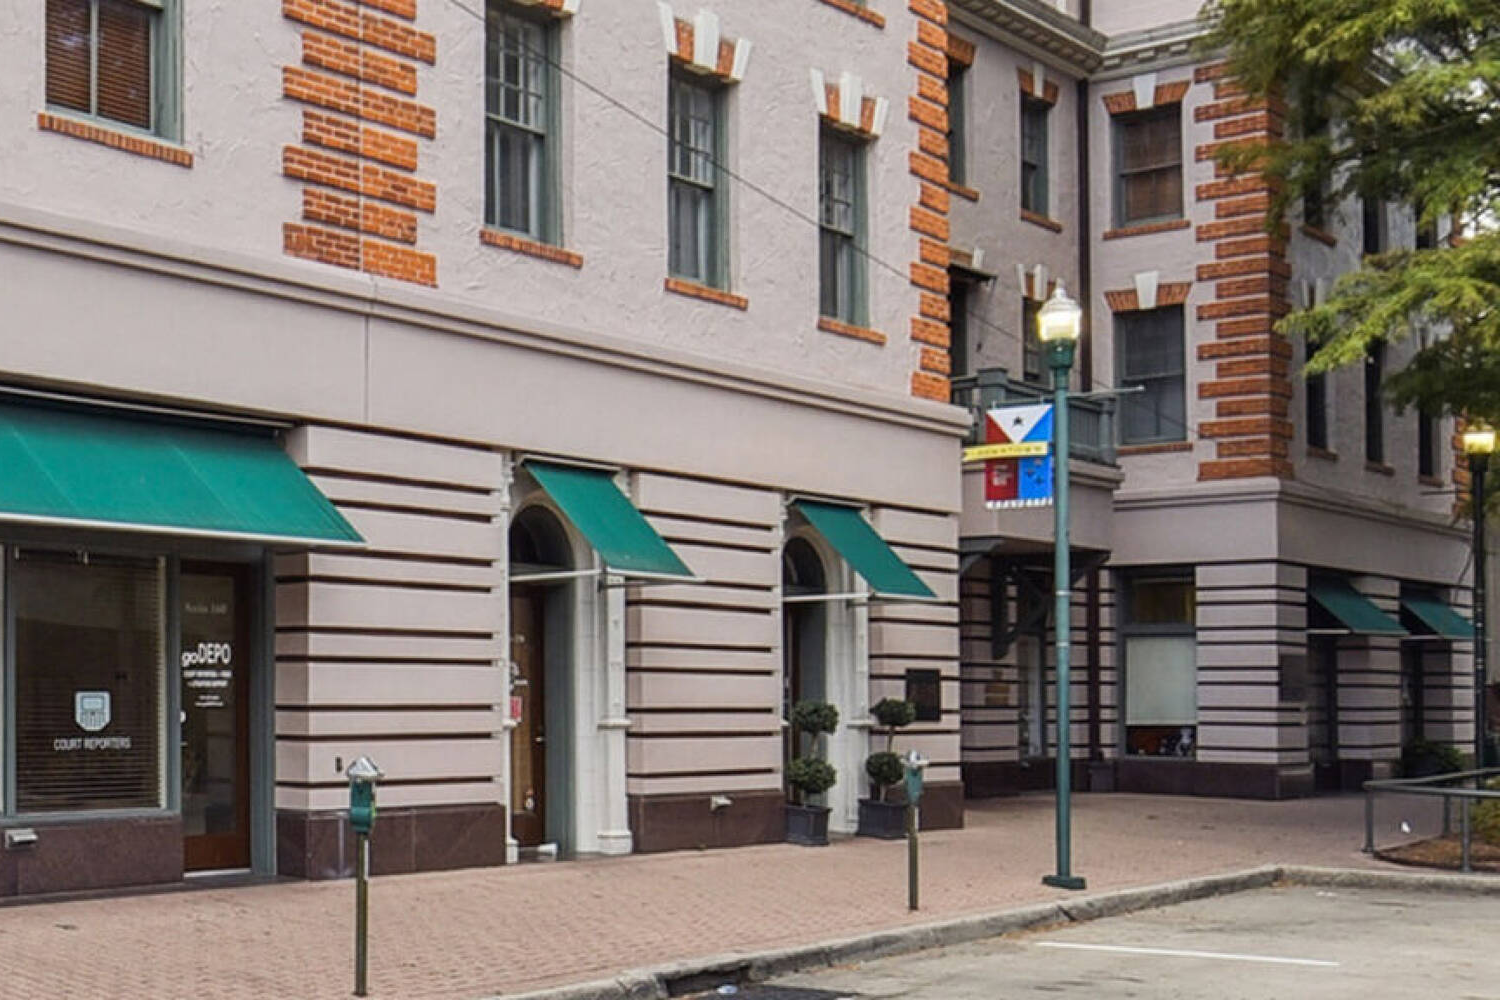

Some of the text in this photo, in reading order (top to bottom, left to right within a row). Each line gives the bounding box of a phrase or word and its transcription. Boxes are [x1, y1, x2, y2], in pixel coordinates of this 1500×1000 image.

[181, 643, 231, 667] goDEPO
[53, 736, 132, 751] COURT REPORTERS
